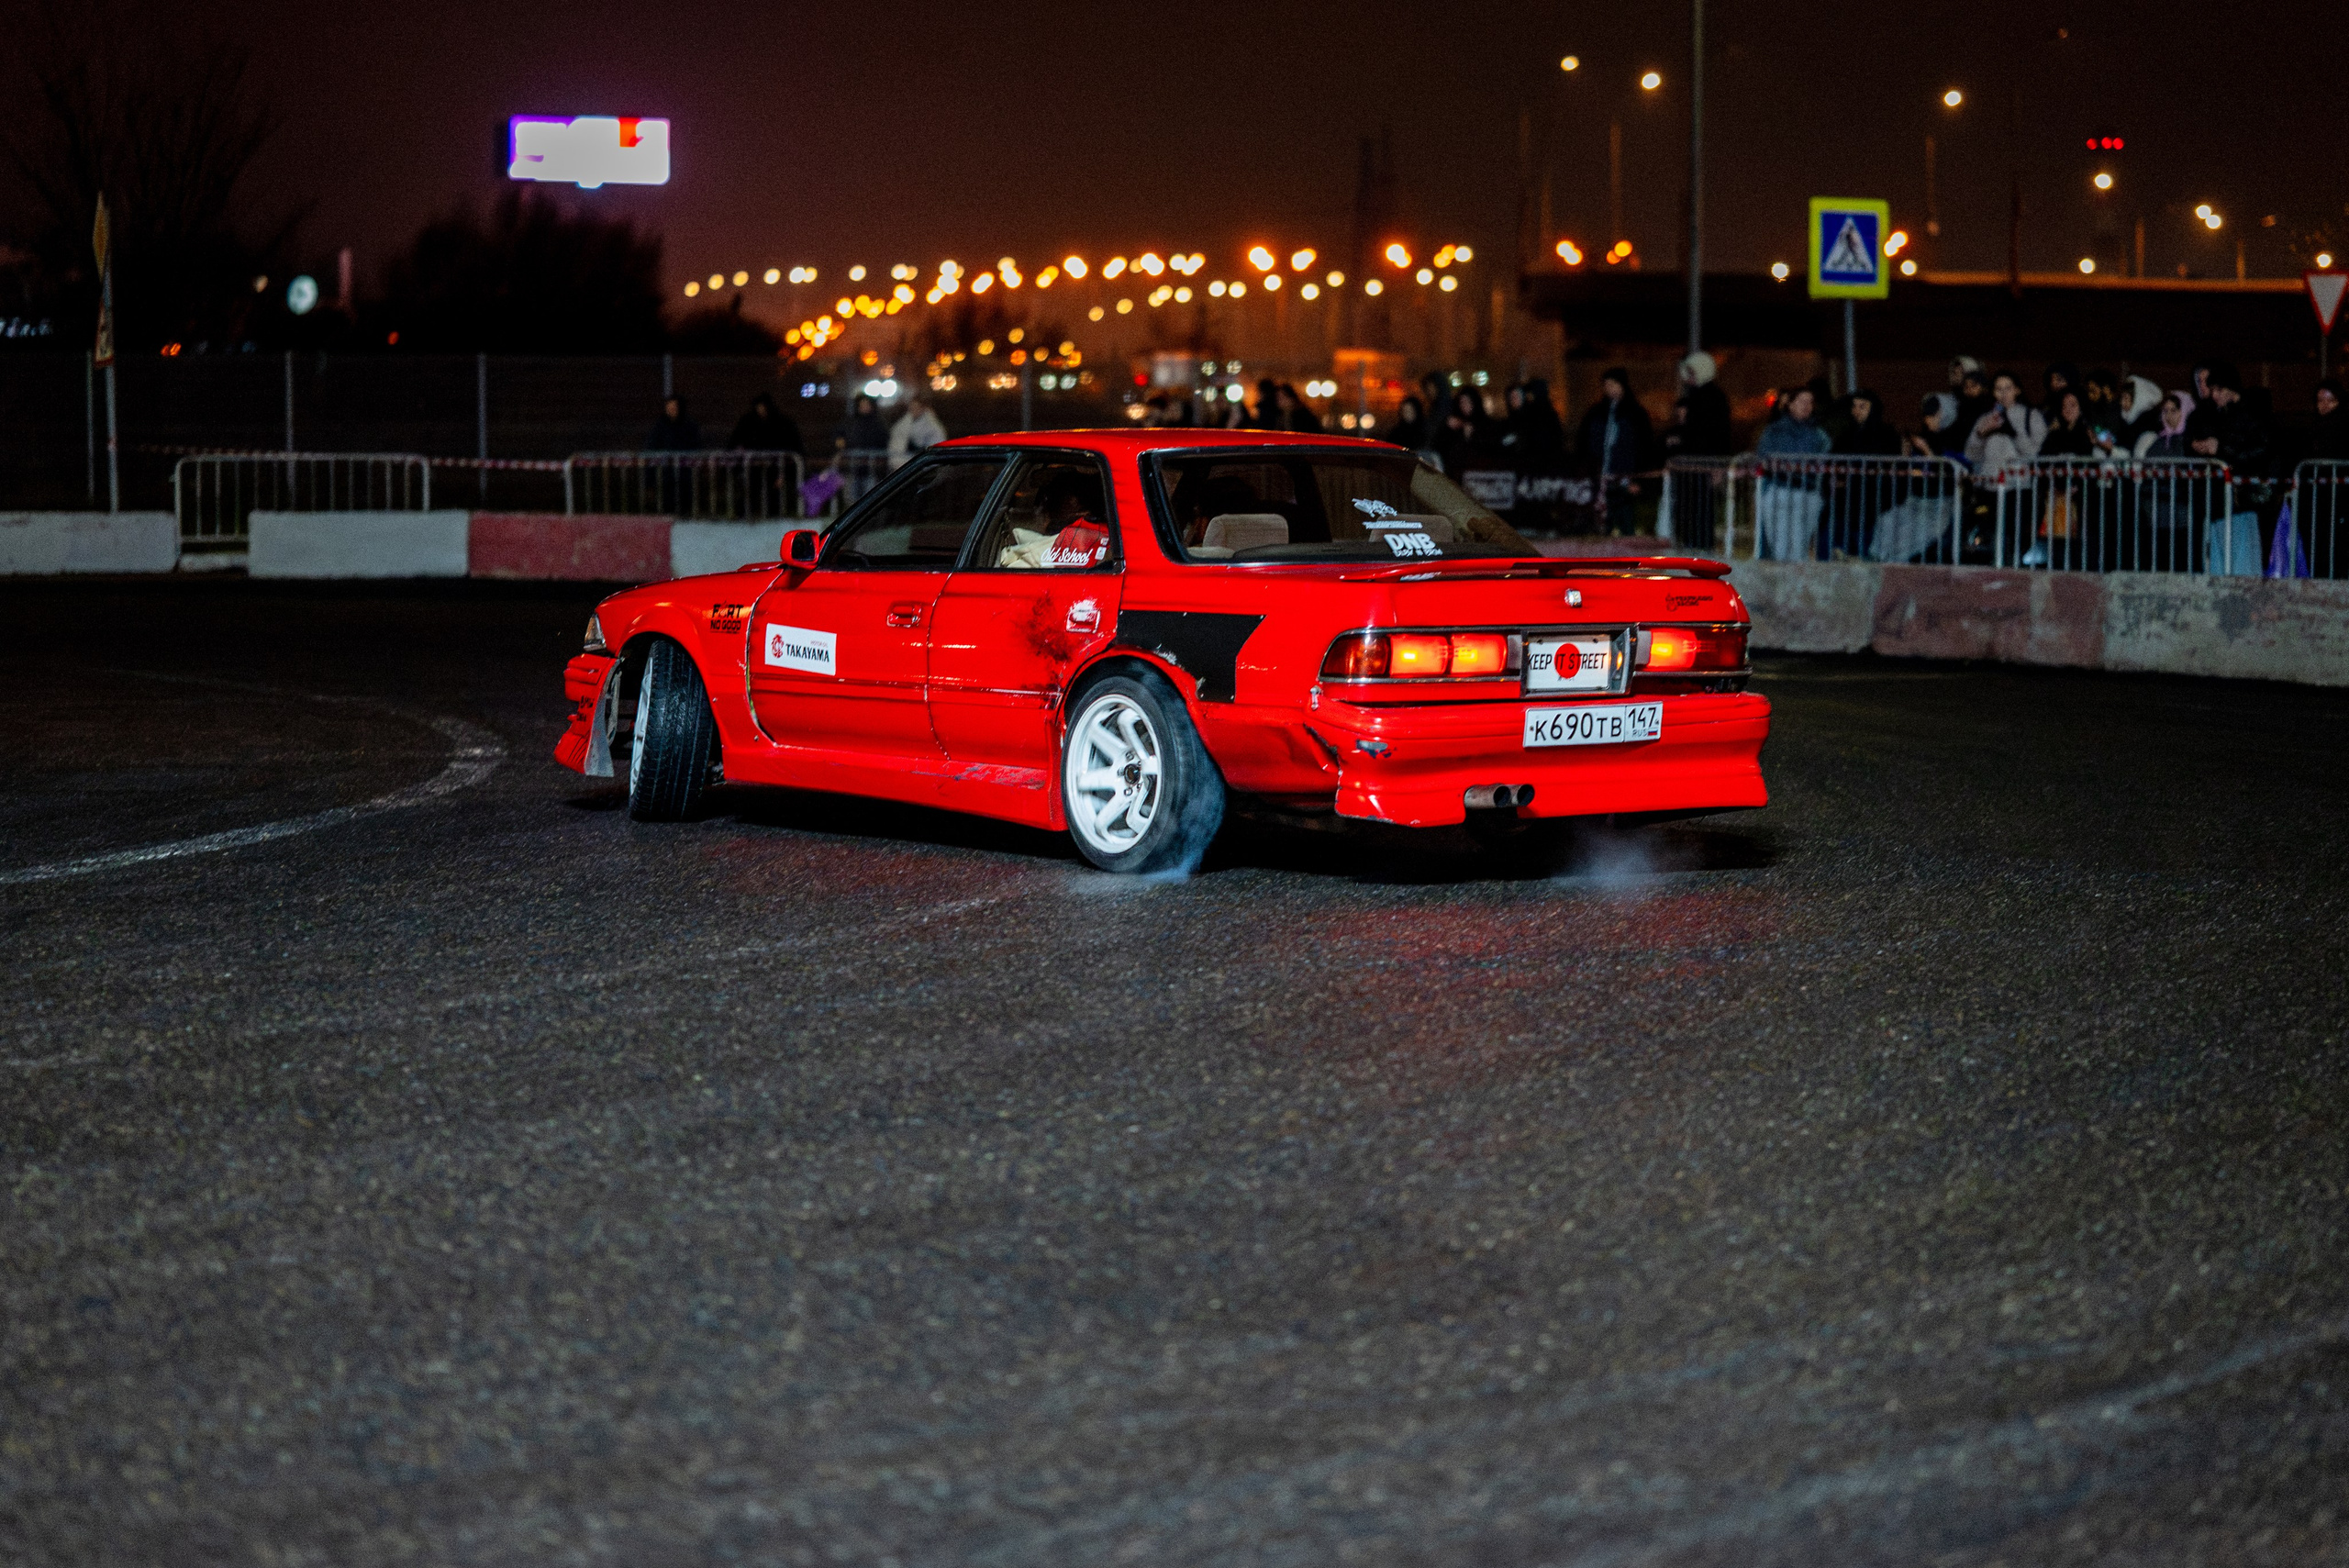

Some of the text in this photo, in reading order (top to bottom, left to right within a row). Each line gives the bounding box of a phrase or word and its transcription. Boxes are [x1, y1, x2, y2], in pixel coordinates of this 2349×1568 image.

[1384, 533, 1436, 550] DNB
[1040, 547, 1094, 564] Old School
[710, 619, 741, 631] NO GOOD
[785, 643, 829, 662] TAKAYAMA
[1529, 653, 1607, 670] KEEP IT STREET
[1628, 706, 1657, 728] 147
[1631, 728, 1647, 738] RUS
